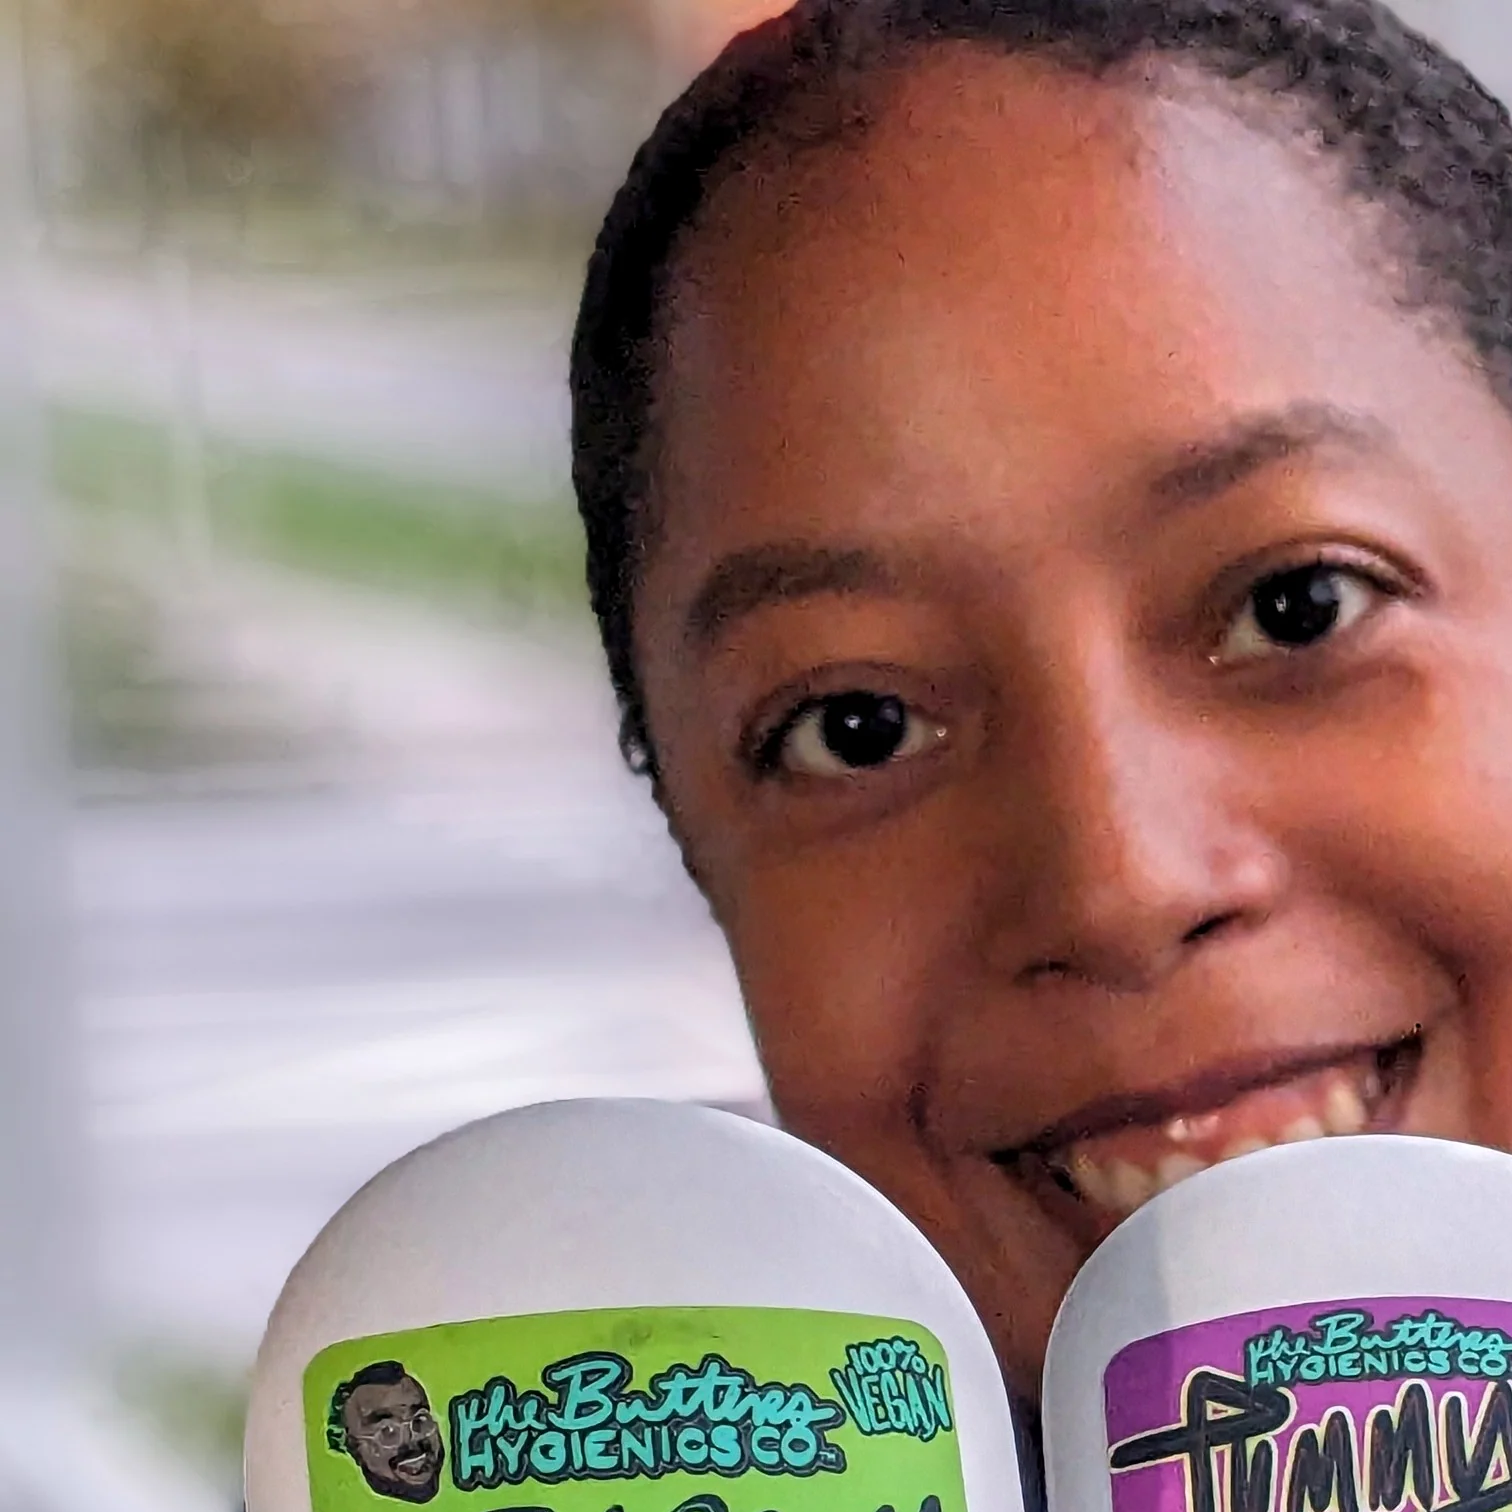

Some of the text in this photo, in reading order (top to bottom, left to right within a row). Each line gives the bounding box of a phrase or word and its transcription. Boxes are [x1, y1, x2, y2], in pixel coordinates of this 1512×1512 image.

[846, 1337, 929, 1375] 100%
[1250, 1349, 1451, 1388] HYGIENICS
[830, 1365, 952, 1441] VEGAN
[459, 1424, 743, 1480] HYGIENICS
